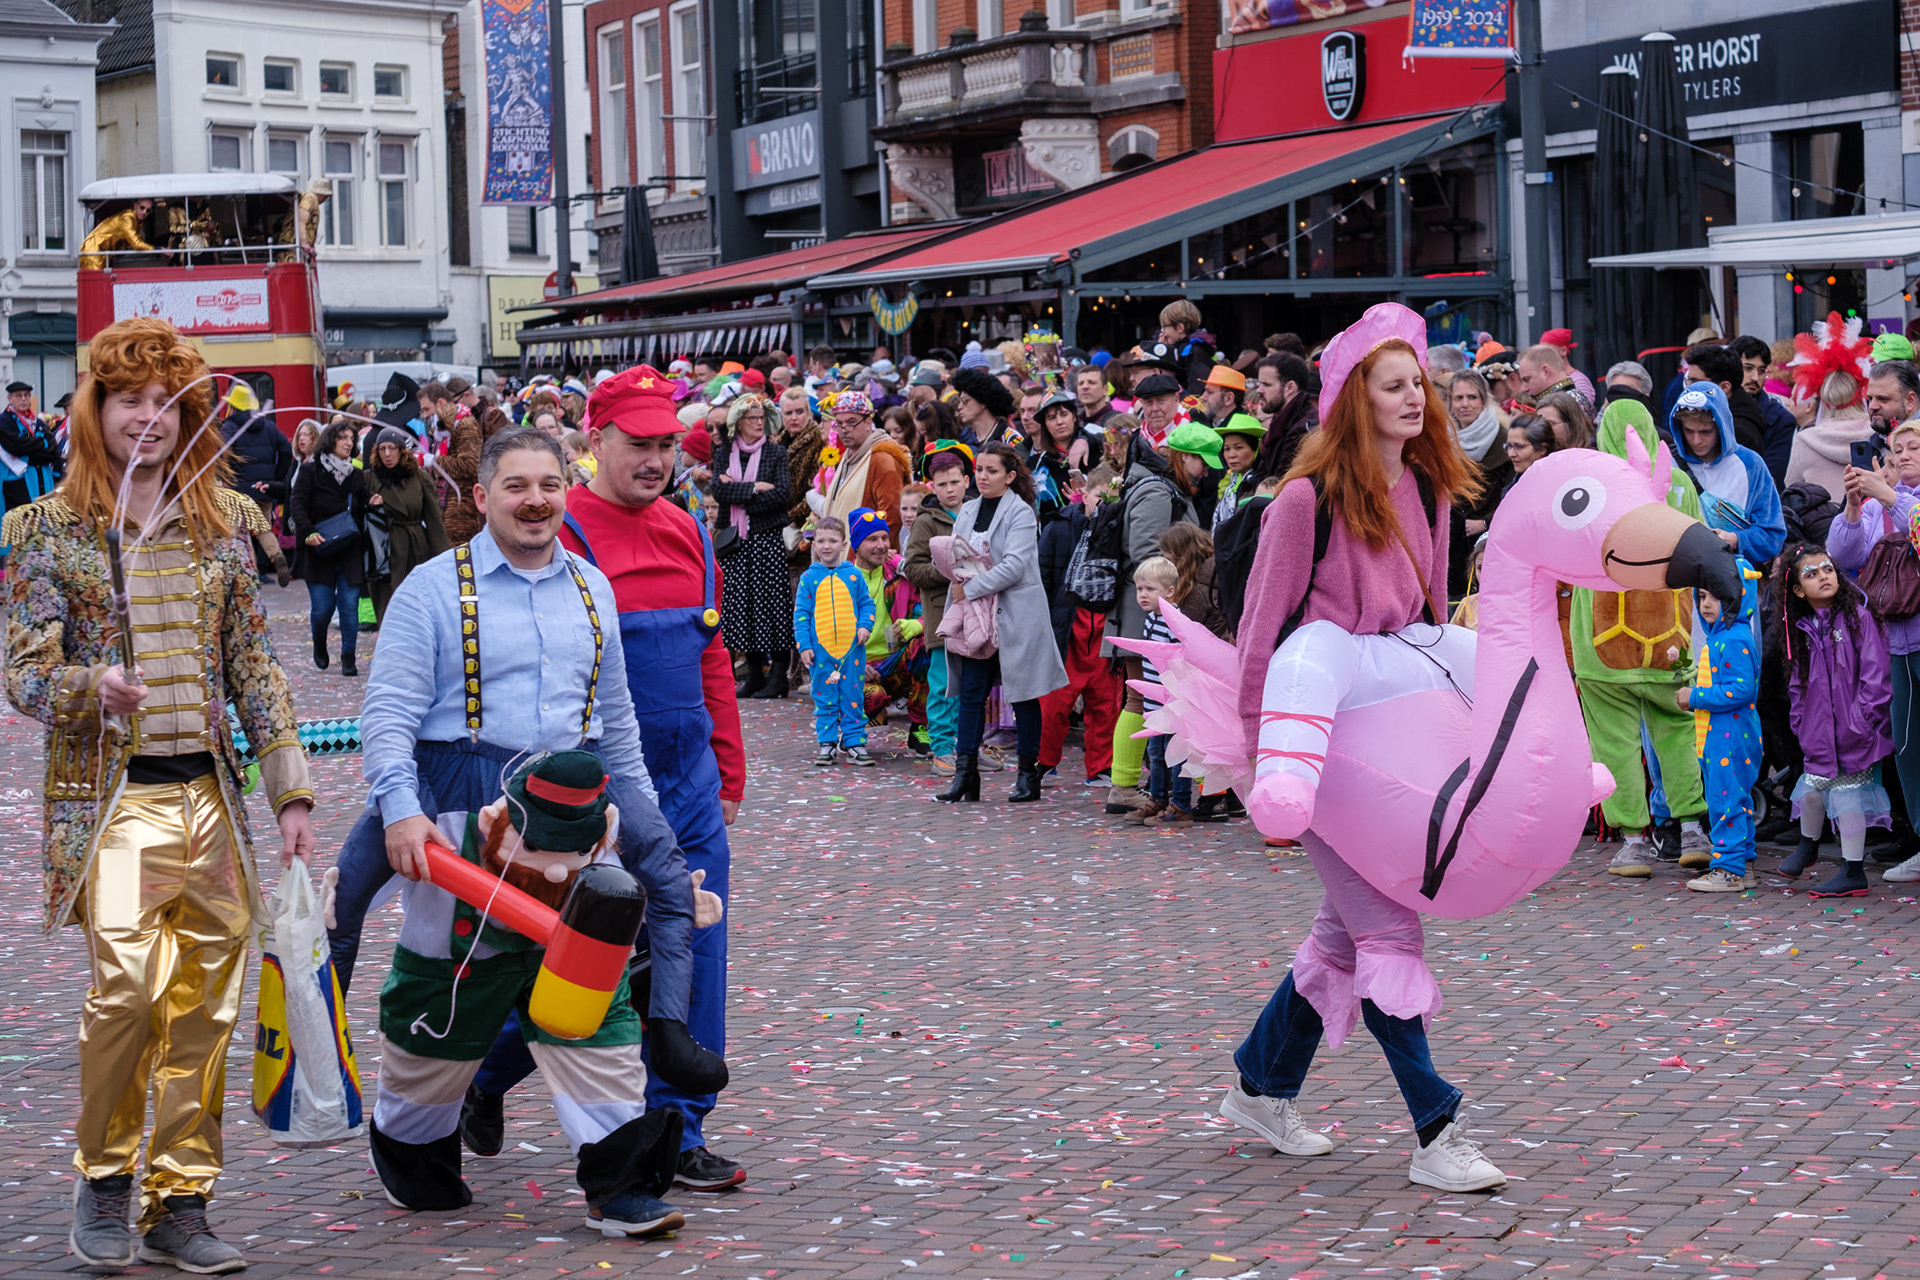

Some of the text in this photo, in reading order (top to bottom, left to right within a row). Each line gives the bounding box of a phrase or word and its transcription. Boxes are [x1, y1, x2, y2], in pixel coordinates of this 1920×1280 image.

[1464, 11, 1503, 26] 2024
[1698, 33, 1762, 70] HORST
[493, 127, 550, 137] STICHTING
[492, 135, 550, 145] CARNAVAL
[760, 121, 815, 175] BRAVO
